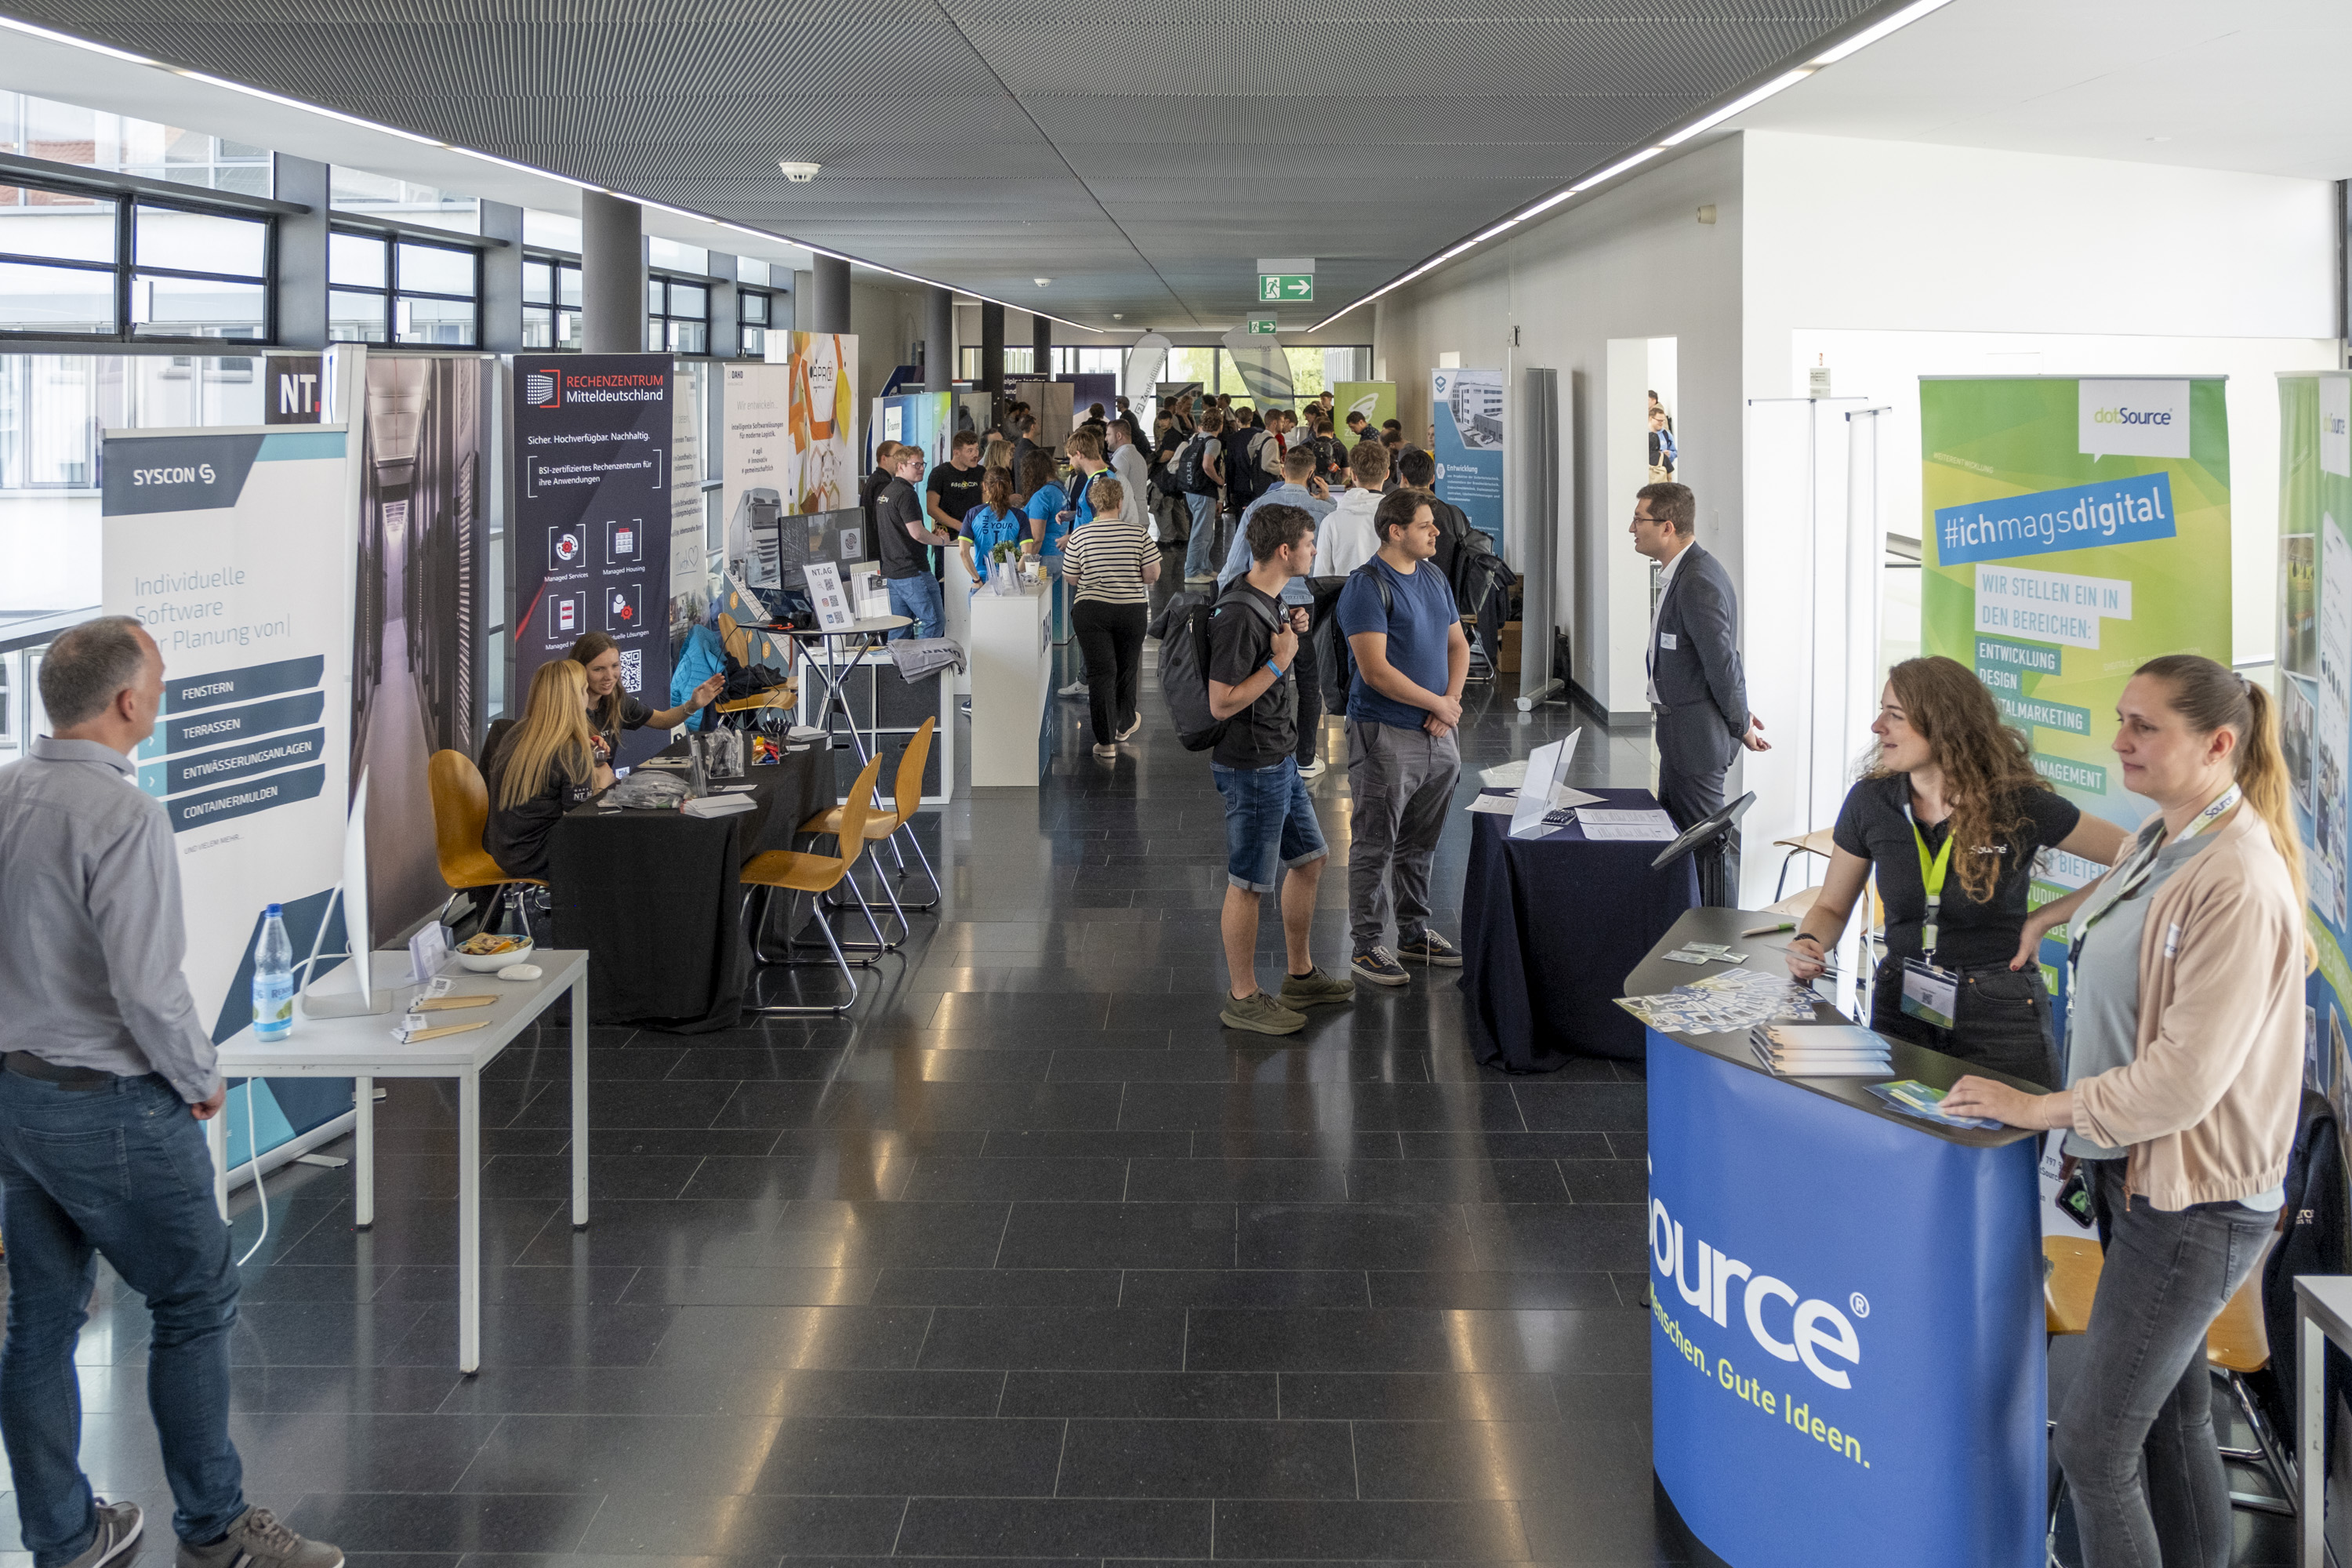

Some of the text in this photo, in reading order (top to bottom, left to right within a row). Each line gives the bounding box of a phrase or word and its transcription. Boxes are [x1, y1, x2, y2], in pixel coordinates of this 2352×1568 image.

[566, 375, 663, 387] RECHENZENTRUM
[566, 389, 663, 403] Mitteldeutschland
[528, 431, 651, 445] Sicher. Hochverfügbar. Nachhaltig.
[539, 464, 592, 474] BSI-zertifiziertes
[593, 462, 641, 471] Rechenzentrum
[1446, 464, 1478, 474] Entwicklung
[1933, 452, 1994, 474] WEITERENTWICKLUNG
[132, 466, 195, 486] SYSCON
[553, 475, 601, 485] Anwendungen
[1944, 486, 2165, 549] #ichmagsdigital
[544, 574, 568, 583] Managed
[626, 565, 645, 574] Housing
[811, 567, 833, 576] NT.AG
[135, 566, 245, 596] Individuelle
[1982, 574, 2118, 609] WIR STELLEN EIN IN
[135, 601, 223, 626] Software
[1983, 605, 2092, 640] DEN BEREICHEN:
[173, 627, 251, 651] Planung
[546, 642, 569, 651] Managed
[1979, 642, 2056, 670] ENTWICKLUNG
[1979, 668, 2017, 689] DESIGN
[182, 681, 234, 700] FENSTERN
[182, 718, 241, 739] TERRASSEN
[183, 741, 312, 780] ENTWÄSSERUNGSANLAGEN
[2034, 760, 2102, 789] ANAGEMENT
[183, 786, 278, 819] CONTAINERMULDEN
[2028, 885, 2063, 904] TUDIU
[1648, 1152, 1871, 1390] ource®
[1718, 1358, 1777, 1415] Gute
[1785, 1392, 1871, 1469] Ideen.
